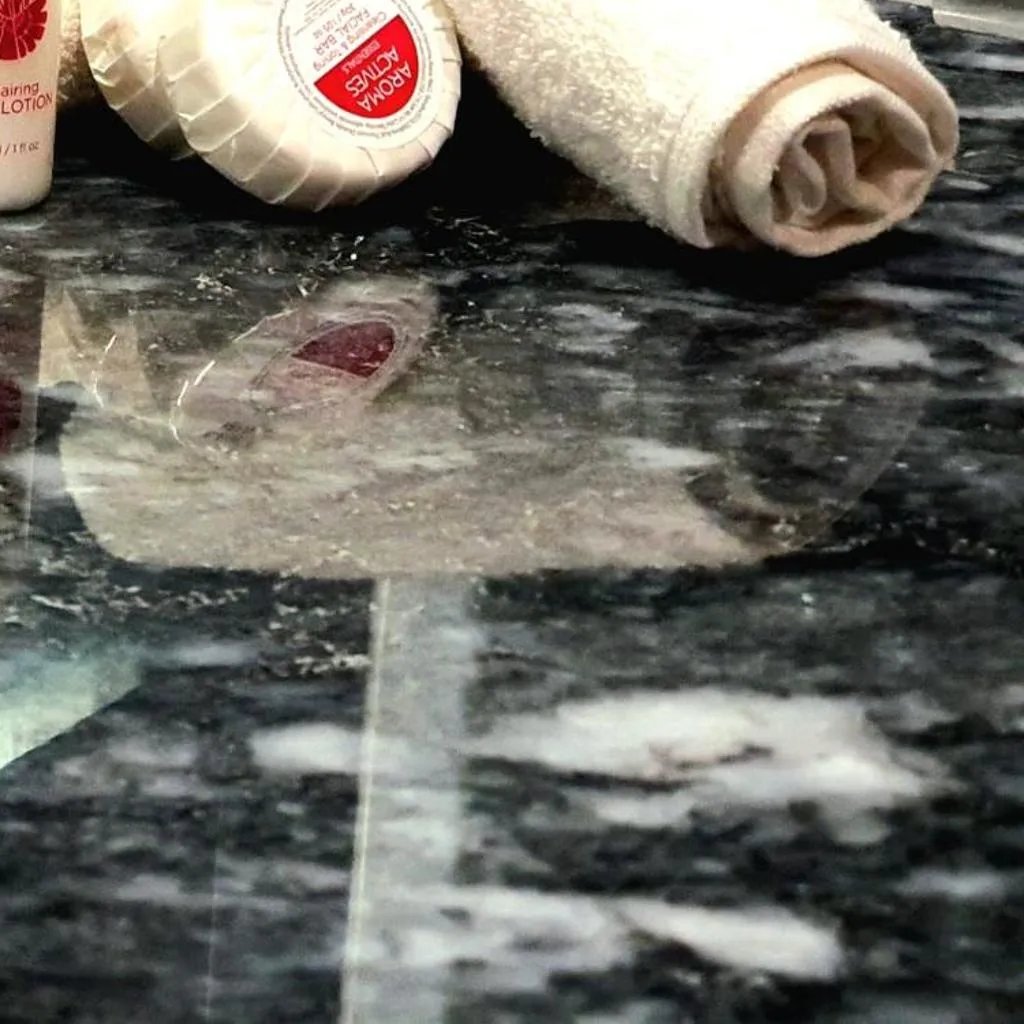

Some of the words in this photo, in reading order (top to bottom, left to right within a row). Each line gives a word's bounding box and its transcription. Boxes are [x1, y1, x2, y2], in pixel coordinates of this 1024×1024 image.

[345, 44, 399, 97] ACTIVES
[357, 61, 412, 112] AROMA
[1, 93, 52, 114] LOTION
